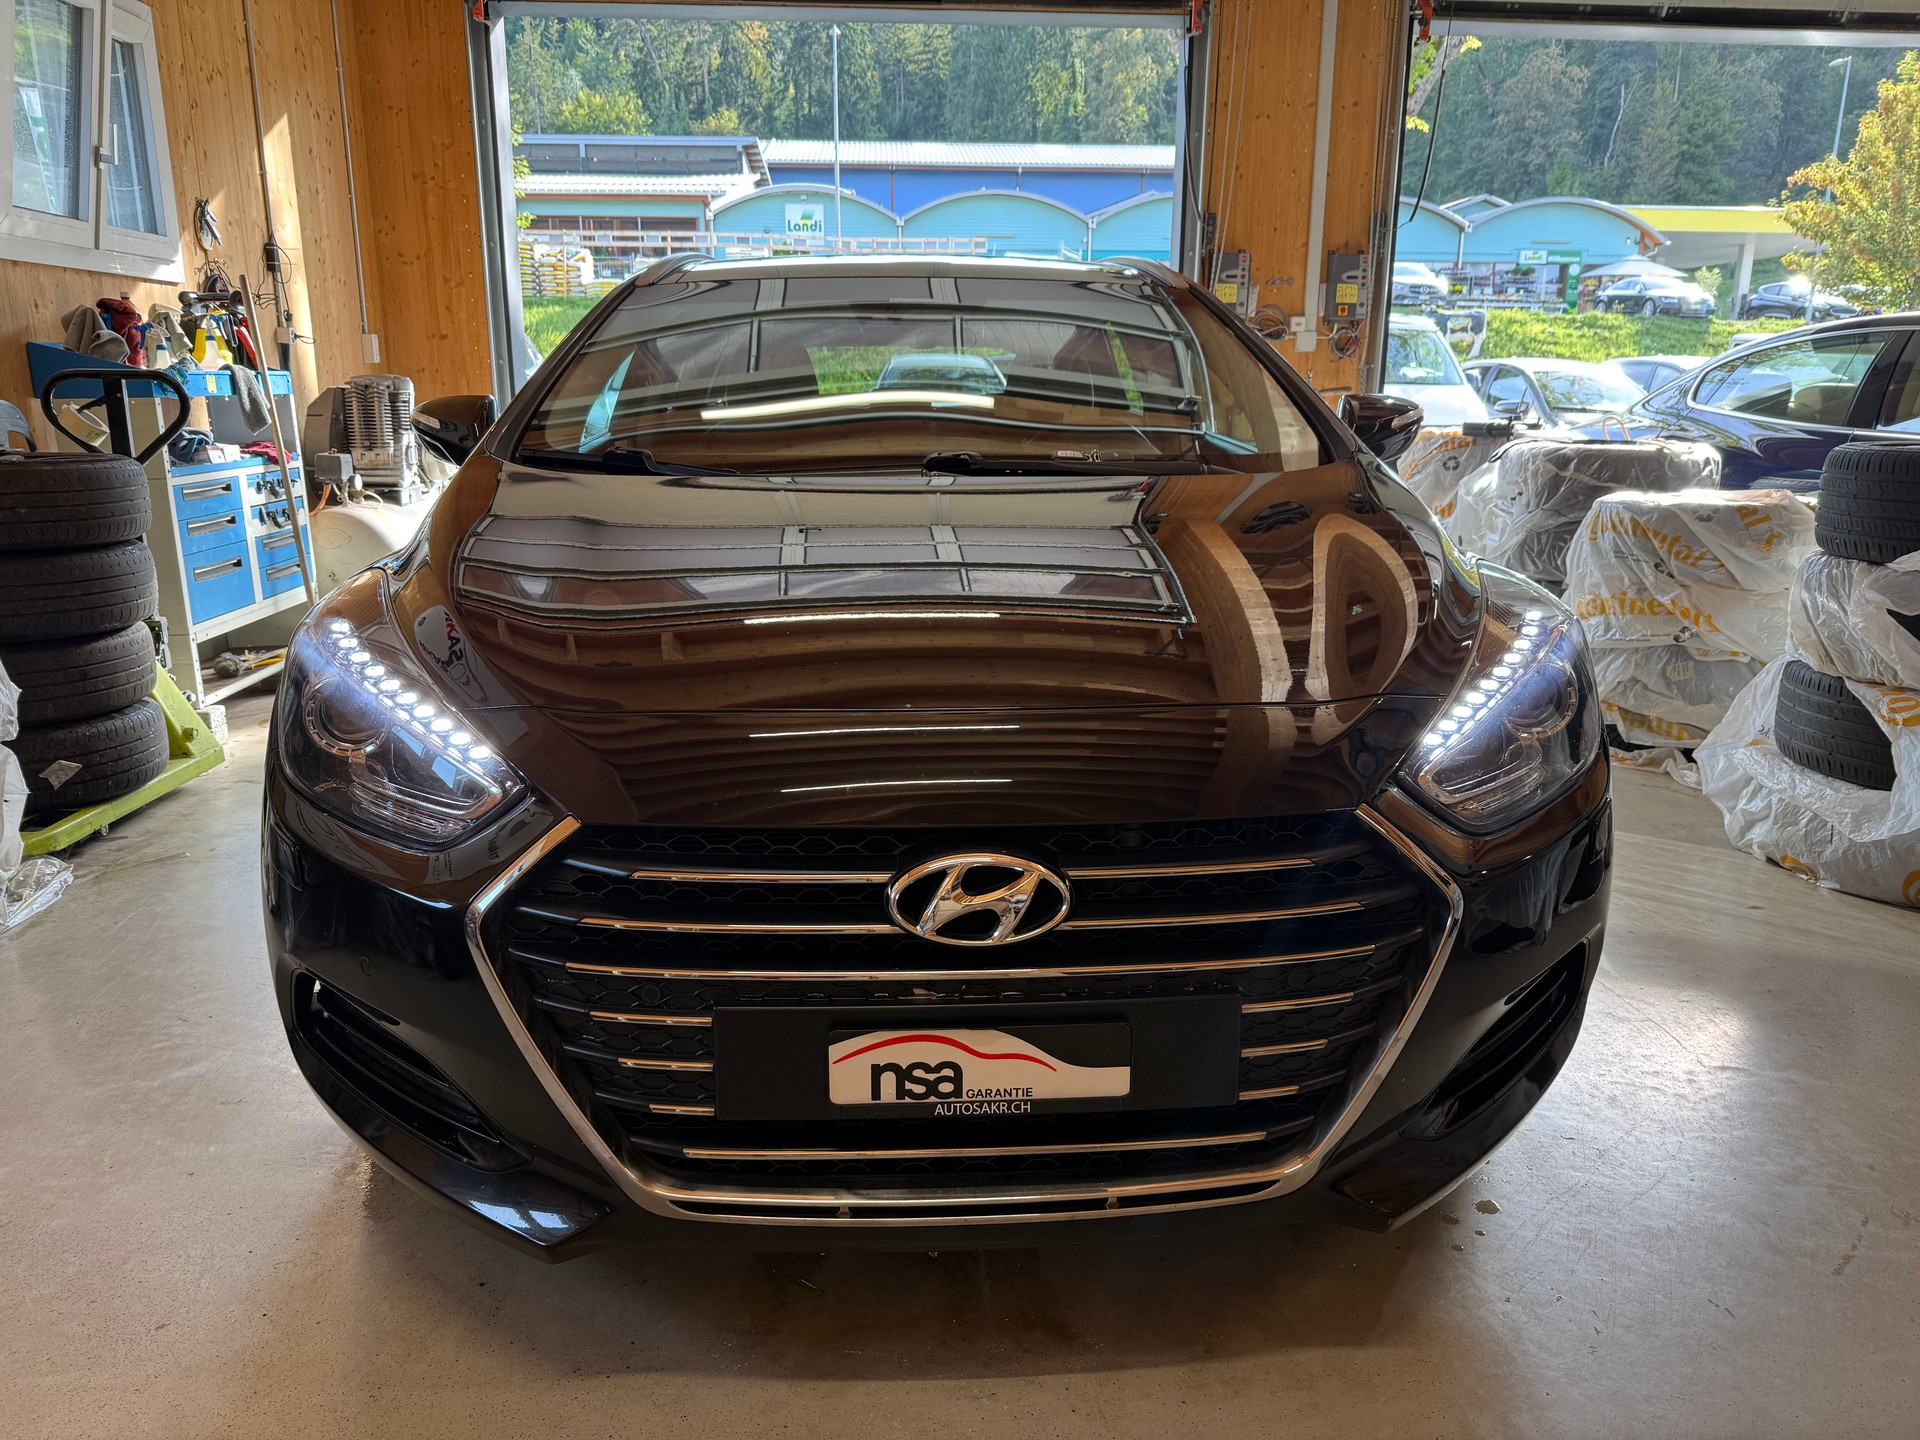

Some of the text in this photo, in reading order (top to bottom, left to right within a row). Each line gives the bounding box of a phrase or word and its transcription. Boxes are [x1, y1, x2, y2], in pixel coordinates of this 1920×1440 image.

[787, 219, 822, 232] Landi
[871, 1061, 1033, 1101] nsa GARANTIE
[934, 1101, 1031, 1116] AUTOSAKR.CH
